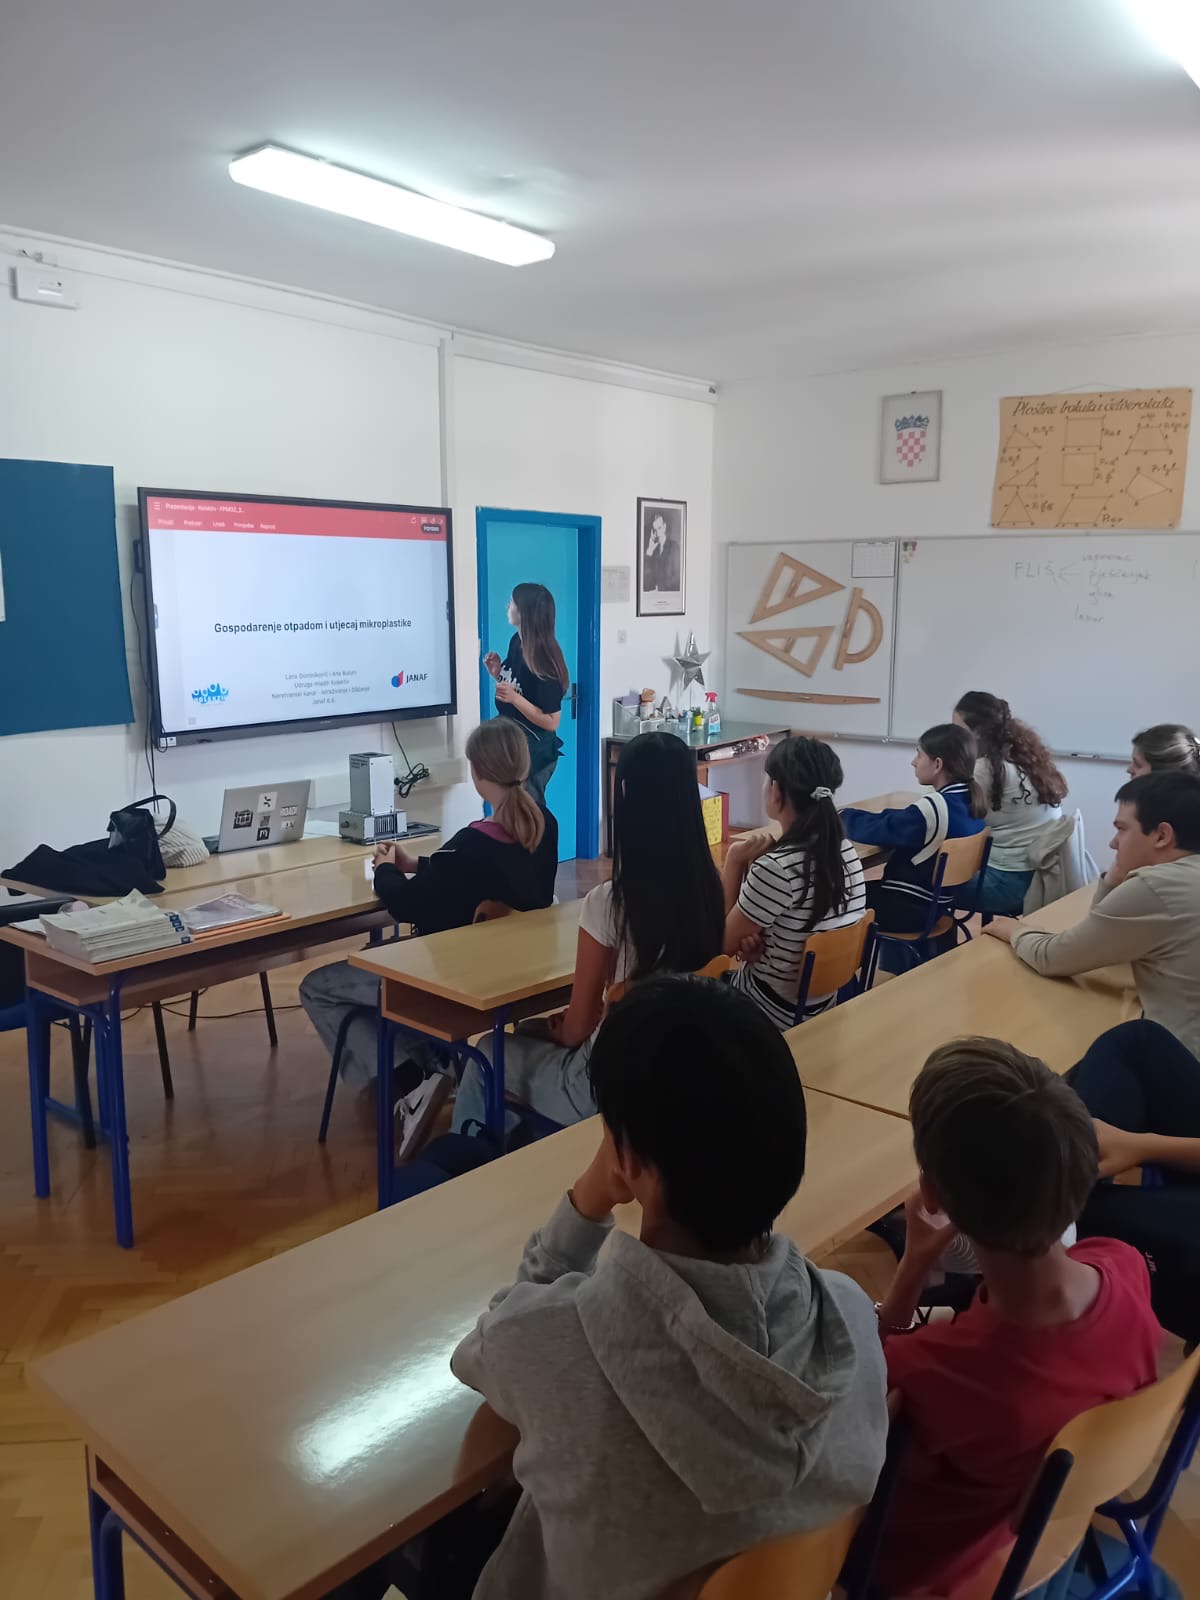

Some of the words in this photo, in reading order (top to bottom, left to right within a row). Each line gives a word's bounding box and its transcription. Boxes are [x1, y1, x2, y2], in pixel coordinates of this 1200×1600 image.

[214, 622, 282, 635] Gospodarenje
[283, 621, 323, 633] otpadom
[329, 620, 358, 631] utjecaj
[360, 619, 412, 630] mikroplastike
[406, 673, 428, 683] JANAF
